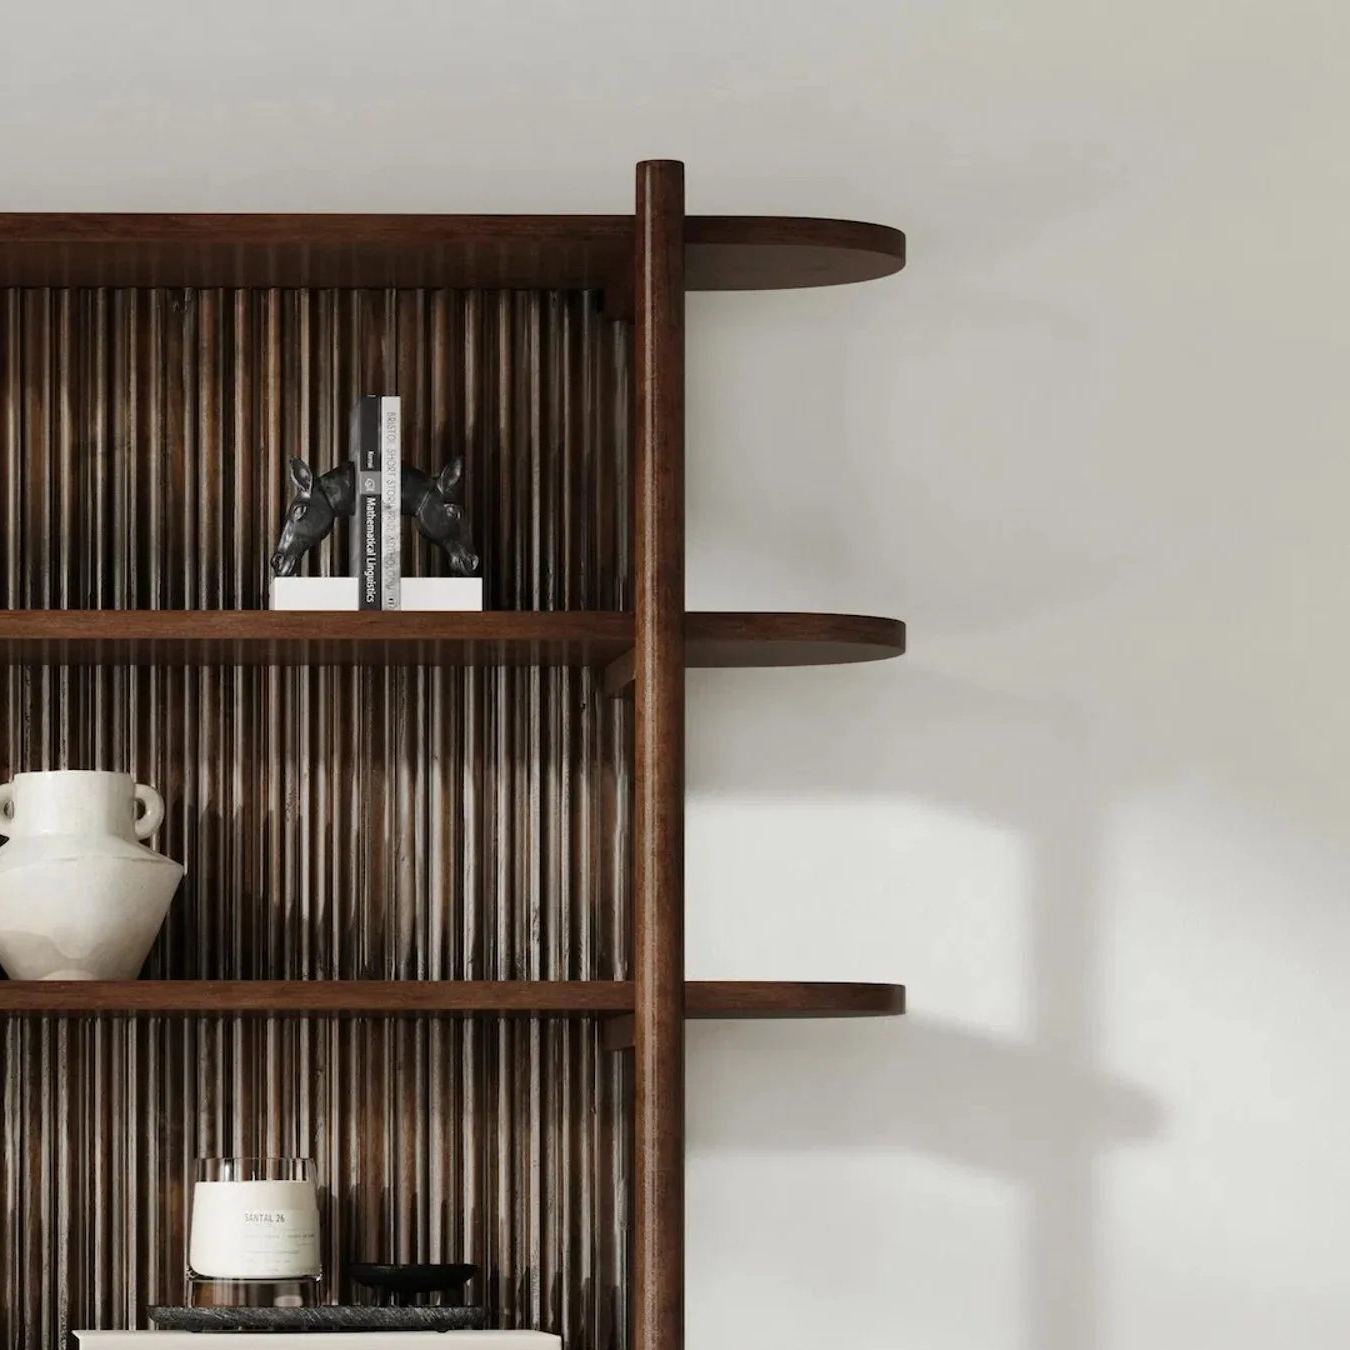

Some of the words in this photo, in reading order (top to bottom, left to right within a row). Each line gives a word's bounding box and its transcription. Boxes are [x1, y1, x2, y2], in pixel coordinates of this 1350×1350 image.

[386, 412, 396, 443] BRISTOL
[386, 449, 396, 476] SHORT
[366, 498, 377, 555] Mathematical
[364, 557, 377, 602] Linguistics
[245, 1213, 274, 1222] SANTAL
[275, 1213, 285, 1222] 26
